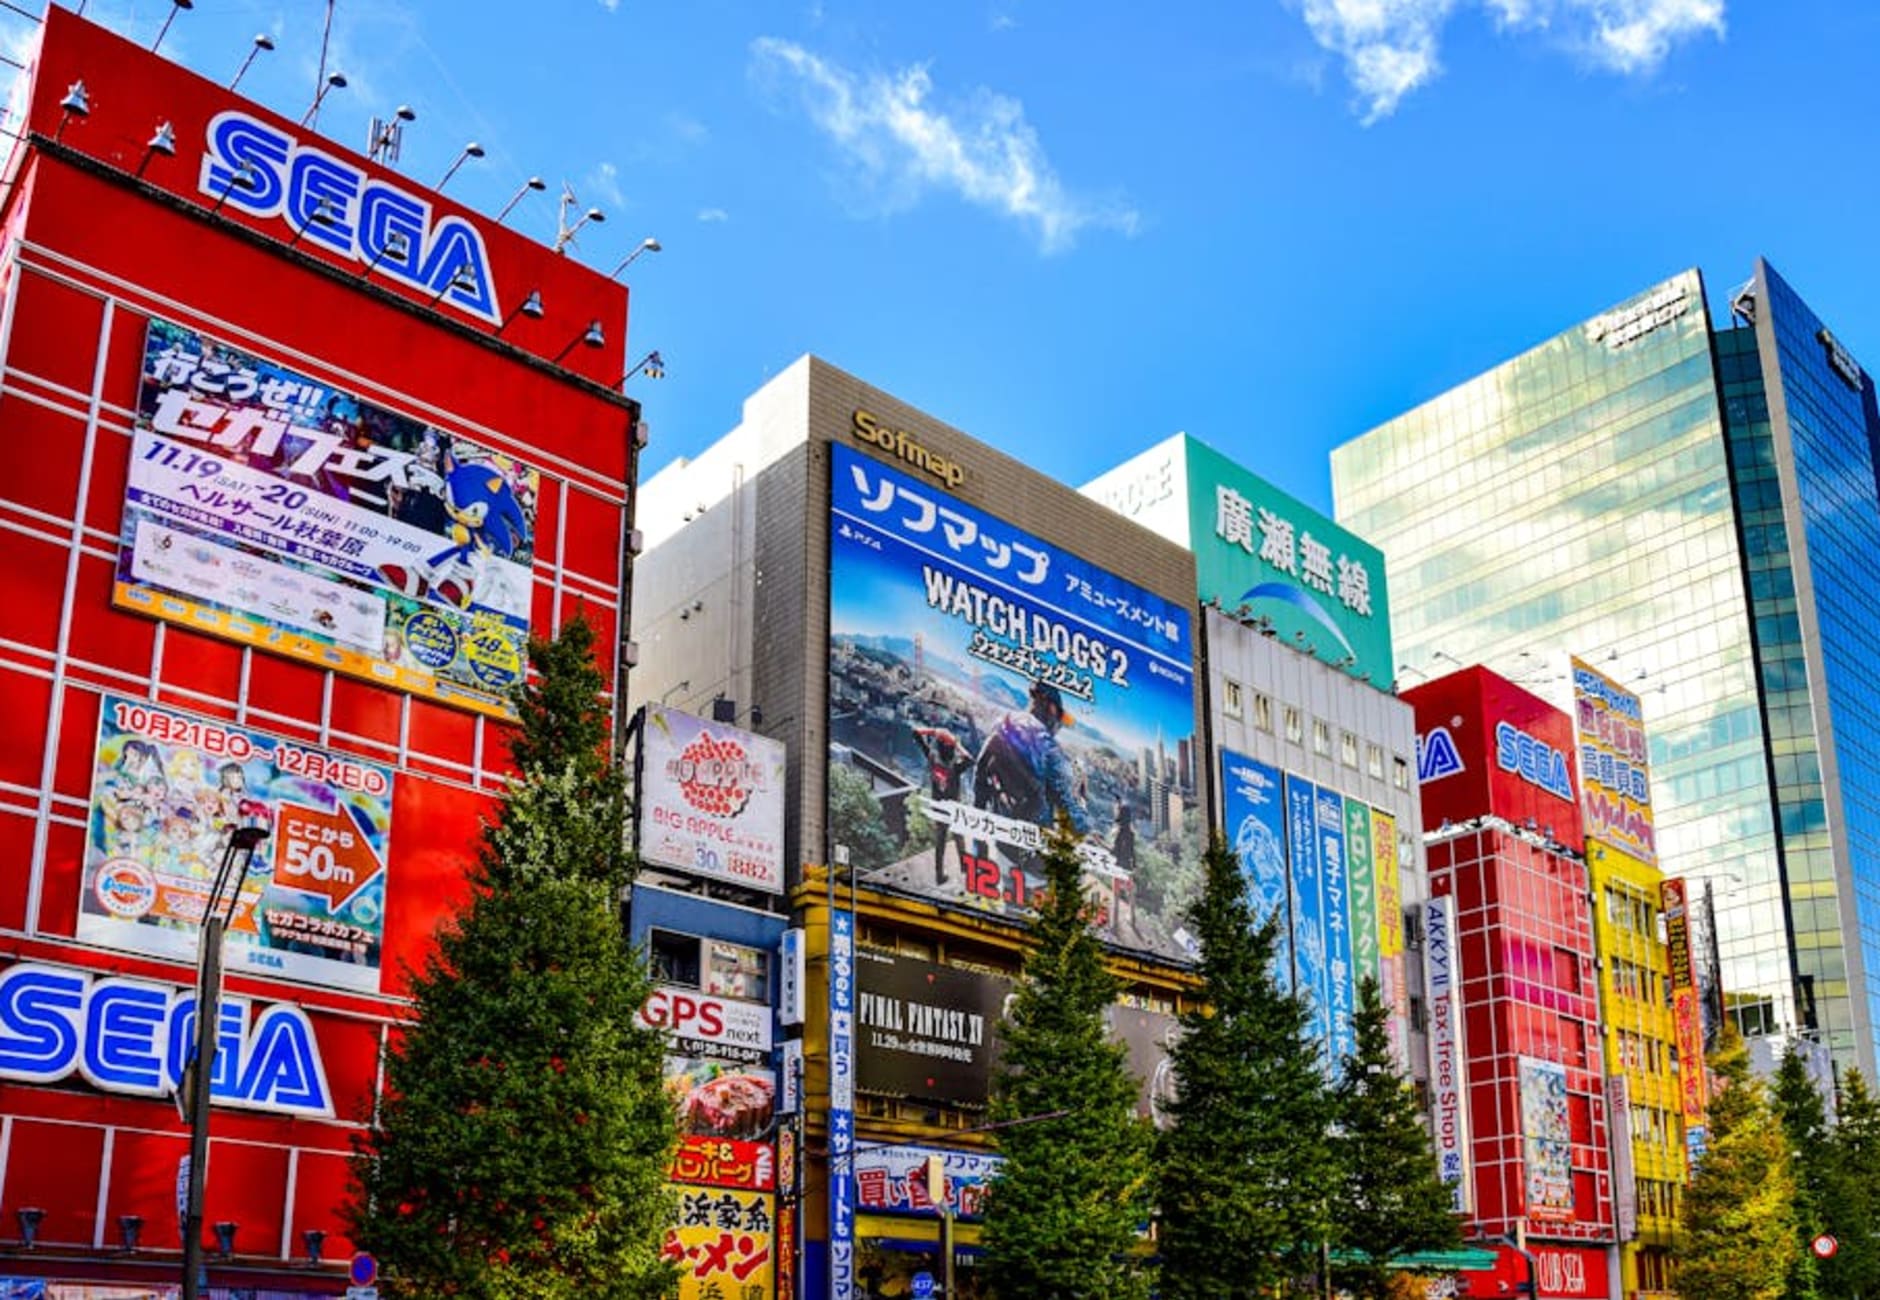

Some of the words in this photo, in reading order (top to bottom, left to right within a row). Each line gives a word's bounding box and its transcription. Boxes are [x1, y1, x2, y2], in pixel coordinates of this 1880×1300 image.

[198, 110, 502, 327] SEGA
[145, 441, 223, 478] 11.19
[853, 410, 965, 487] Sofmap
[851, 465, 1050, 585] ソフマップ
[1064, 572, 1180, 643] アミューズメント館
[1496, 720, 1574, 803] SEGA
[285, 818, 355, 850] ここから
[653, 805, 683, 829] BIG
[685, 815, 735, 843] APPLE
[284, 840, 355, 885] 50m
[247, 952, 285, 969] SEGA
[639, 990, 724, 1037] GPS
[726, 1027, 762, 1045] next
[860, 992, 903, 1030] FINAL
[908, 1003, 967, 1043] FANTASY
[1427, 905, 1449, 970] AKKY
[1440, 1091, 1457, 1149] Shop
[0, 962, 336, 1120] SEGA
[754, 1145, 773, 1187] 2F
[1562, 1252, 1586, 1293] SEGA
